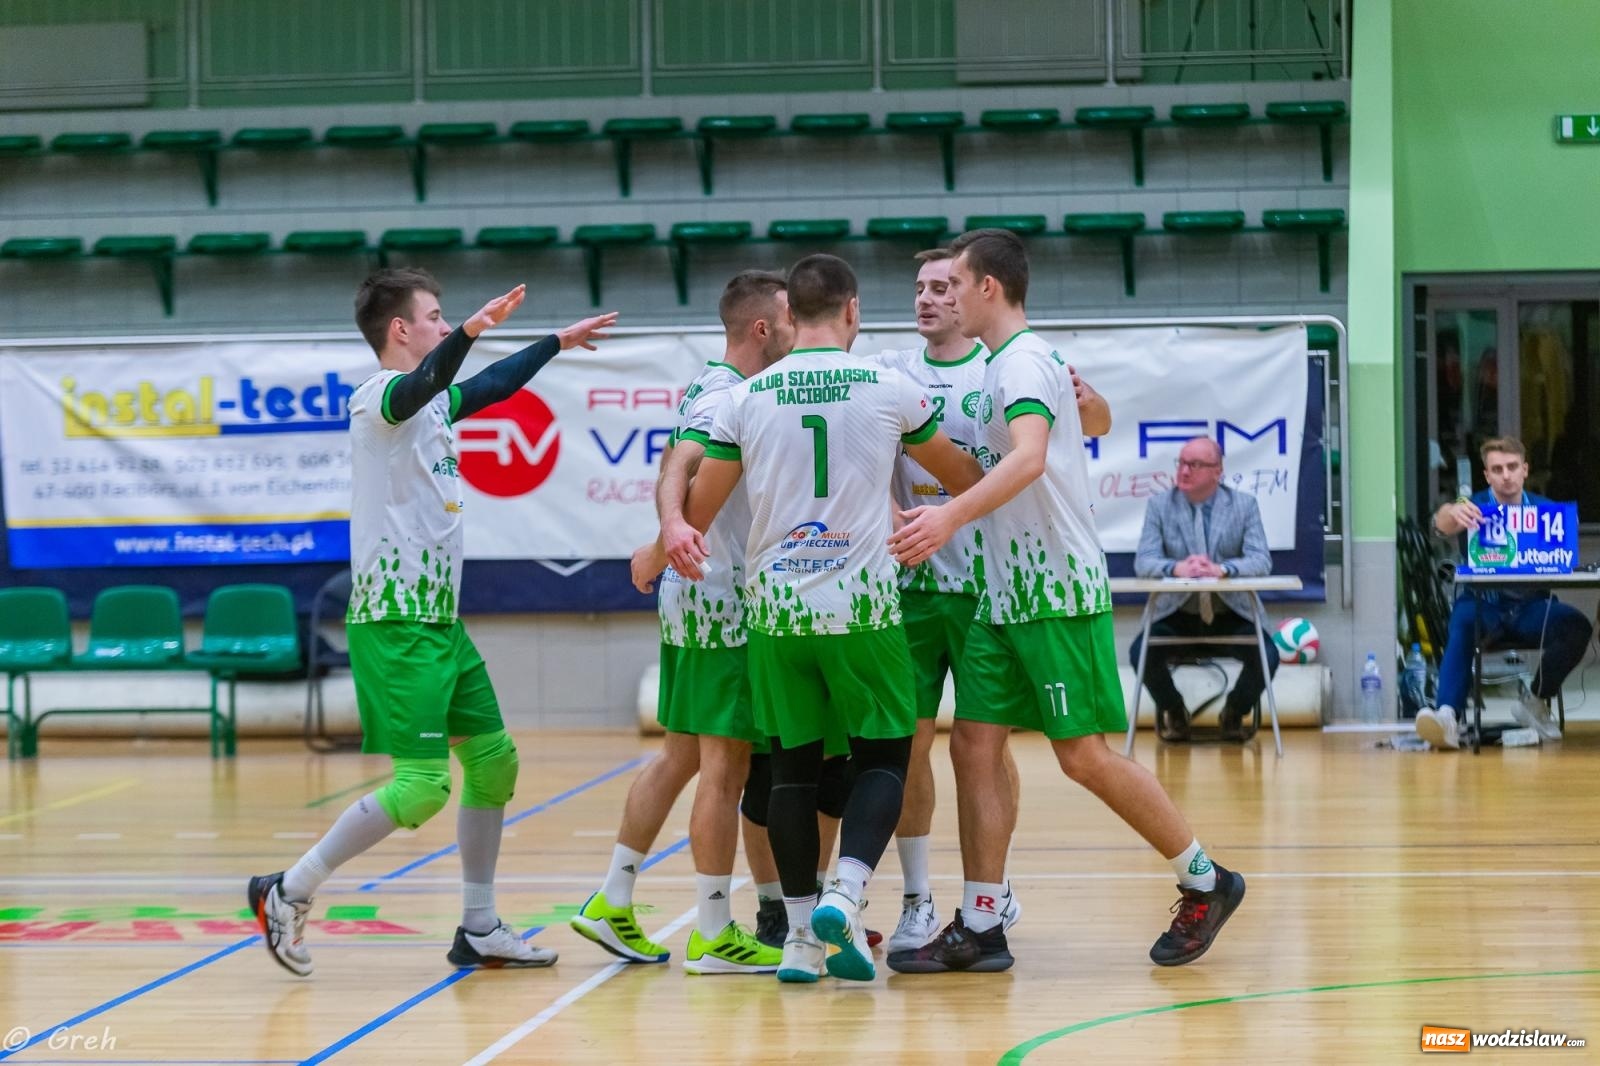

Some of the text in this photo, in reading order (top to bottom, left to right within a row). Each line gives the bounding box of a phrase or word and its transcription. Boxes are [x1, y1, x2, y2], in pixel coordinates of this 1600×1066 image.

[749, 368, 879, 393] KLUB SIATKARSKI
[60, 371, 357, 425] instal-tech
[776, 384, 851, 405] RACIBÓRZ
[1139, 418, 1287, 458] FM
[1541, 511, 1565, 542] 14
[1516, 548, 1573, 568] utterfly
[975, 895, 995, 910] R
